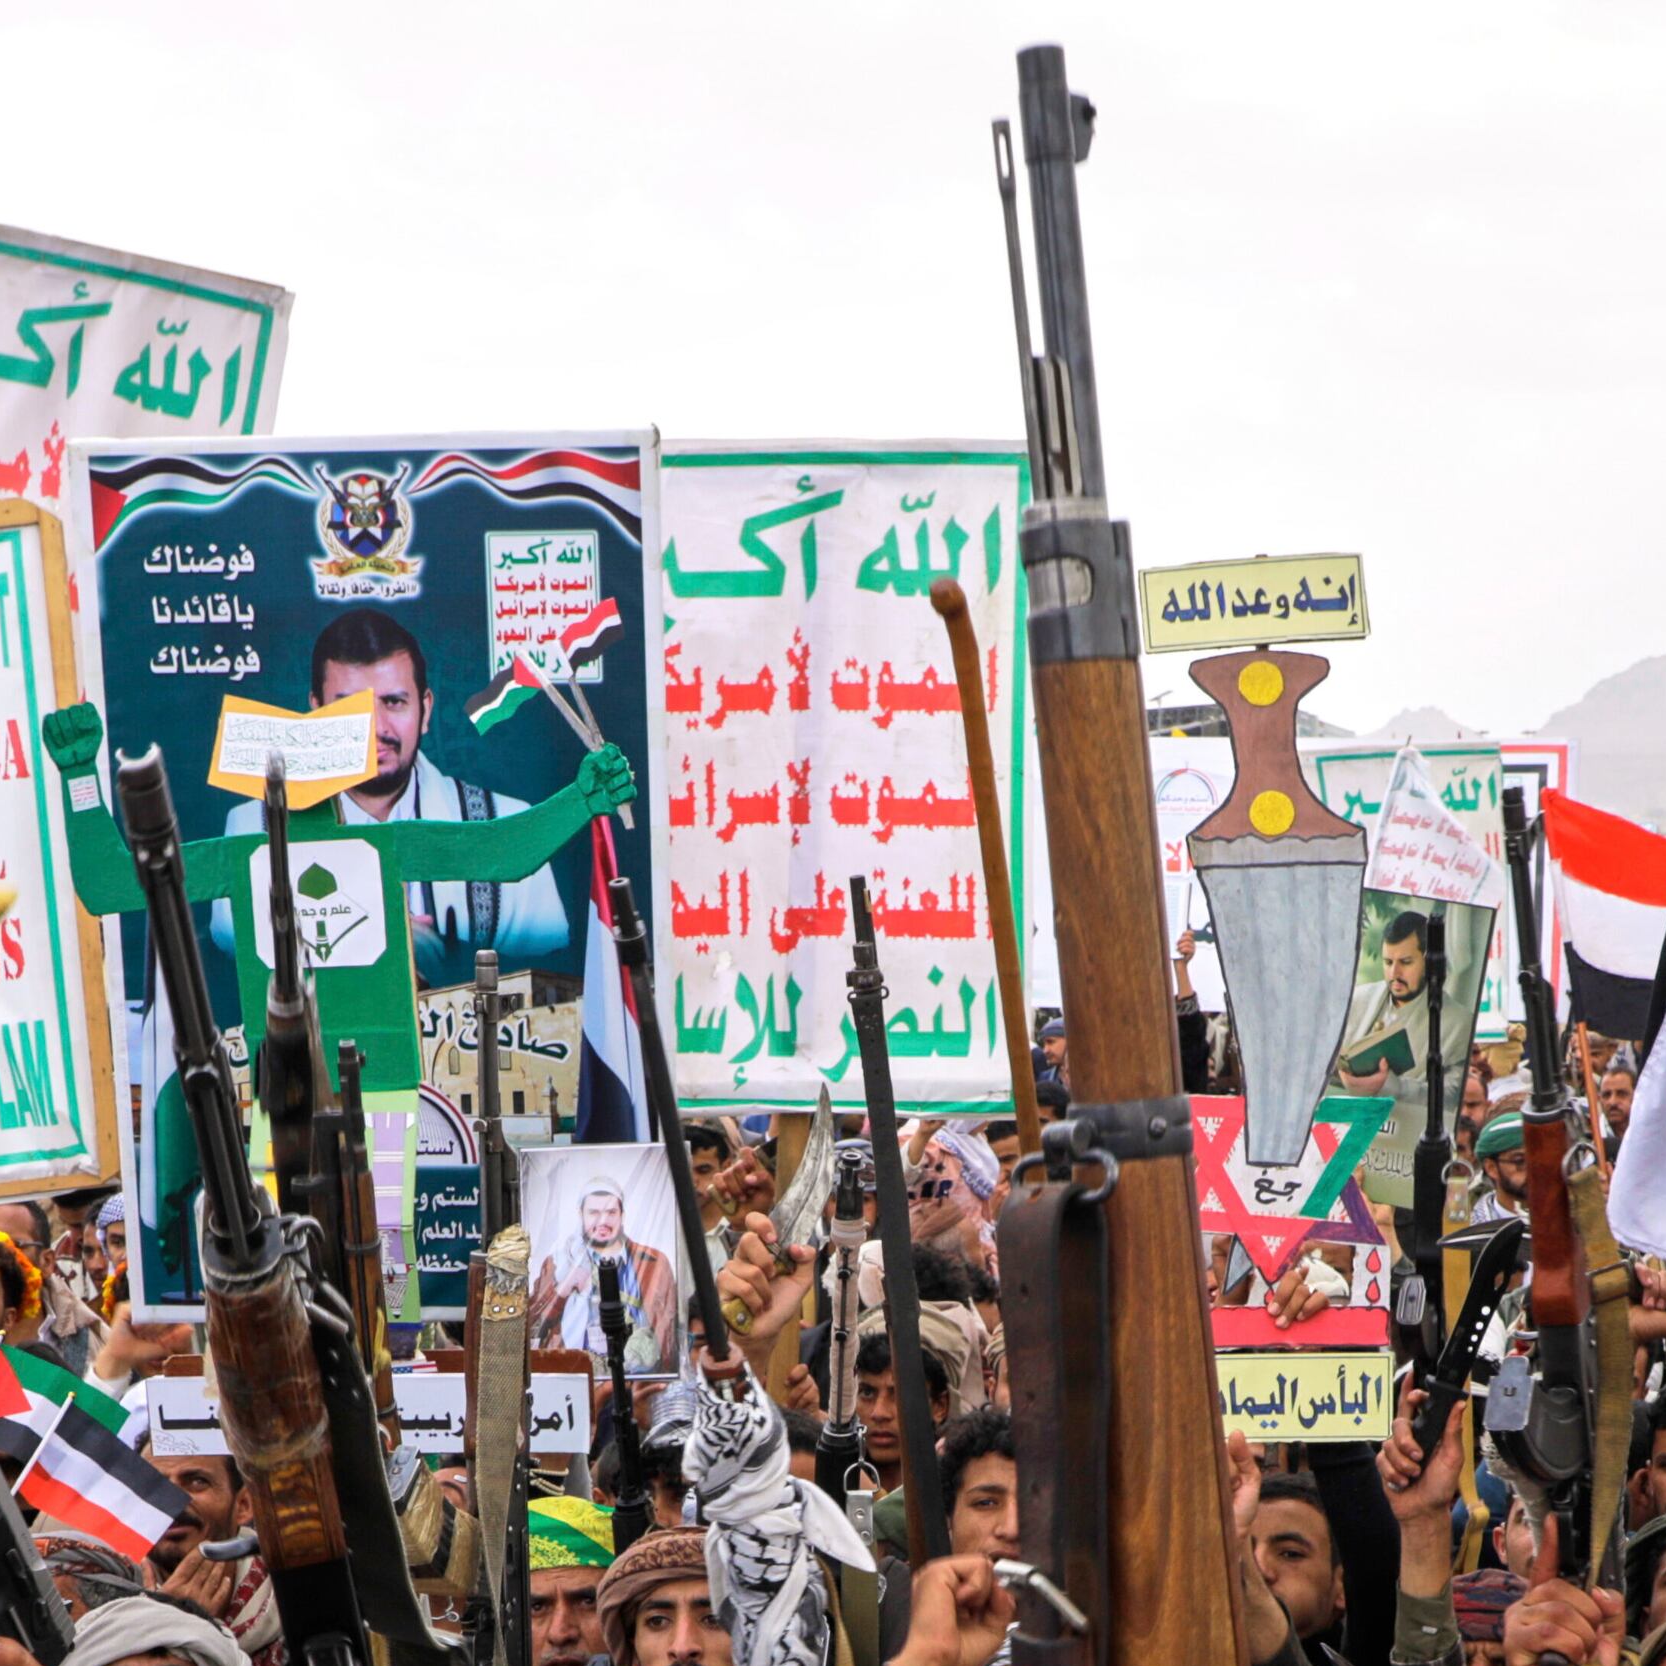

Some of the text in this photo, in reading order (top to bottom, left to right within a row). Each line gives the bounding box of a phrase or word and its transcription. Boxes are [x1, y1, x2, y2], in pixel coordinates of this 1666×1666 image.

[113, 317, 242, 428] الله
[143, 544, 255, 582] فوضناك
[494, 537, 593, 570] الله أكبر
[494, 573, 593, 595] الموت لأمريكا
[1161, 573, 1358, 626] إنه وعد الله
[495, 599, 594, 620] الموت لإسرائيل
[496, 626, 557, 646] على اليهود
[149, 644, 261, 680] فوضناك
[769, 867, 847, 956] على
[432, 1186, 480, 1212] لستم
[1298, 1364, 1383, 1430] البأس
